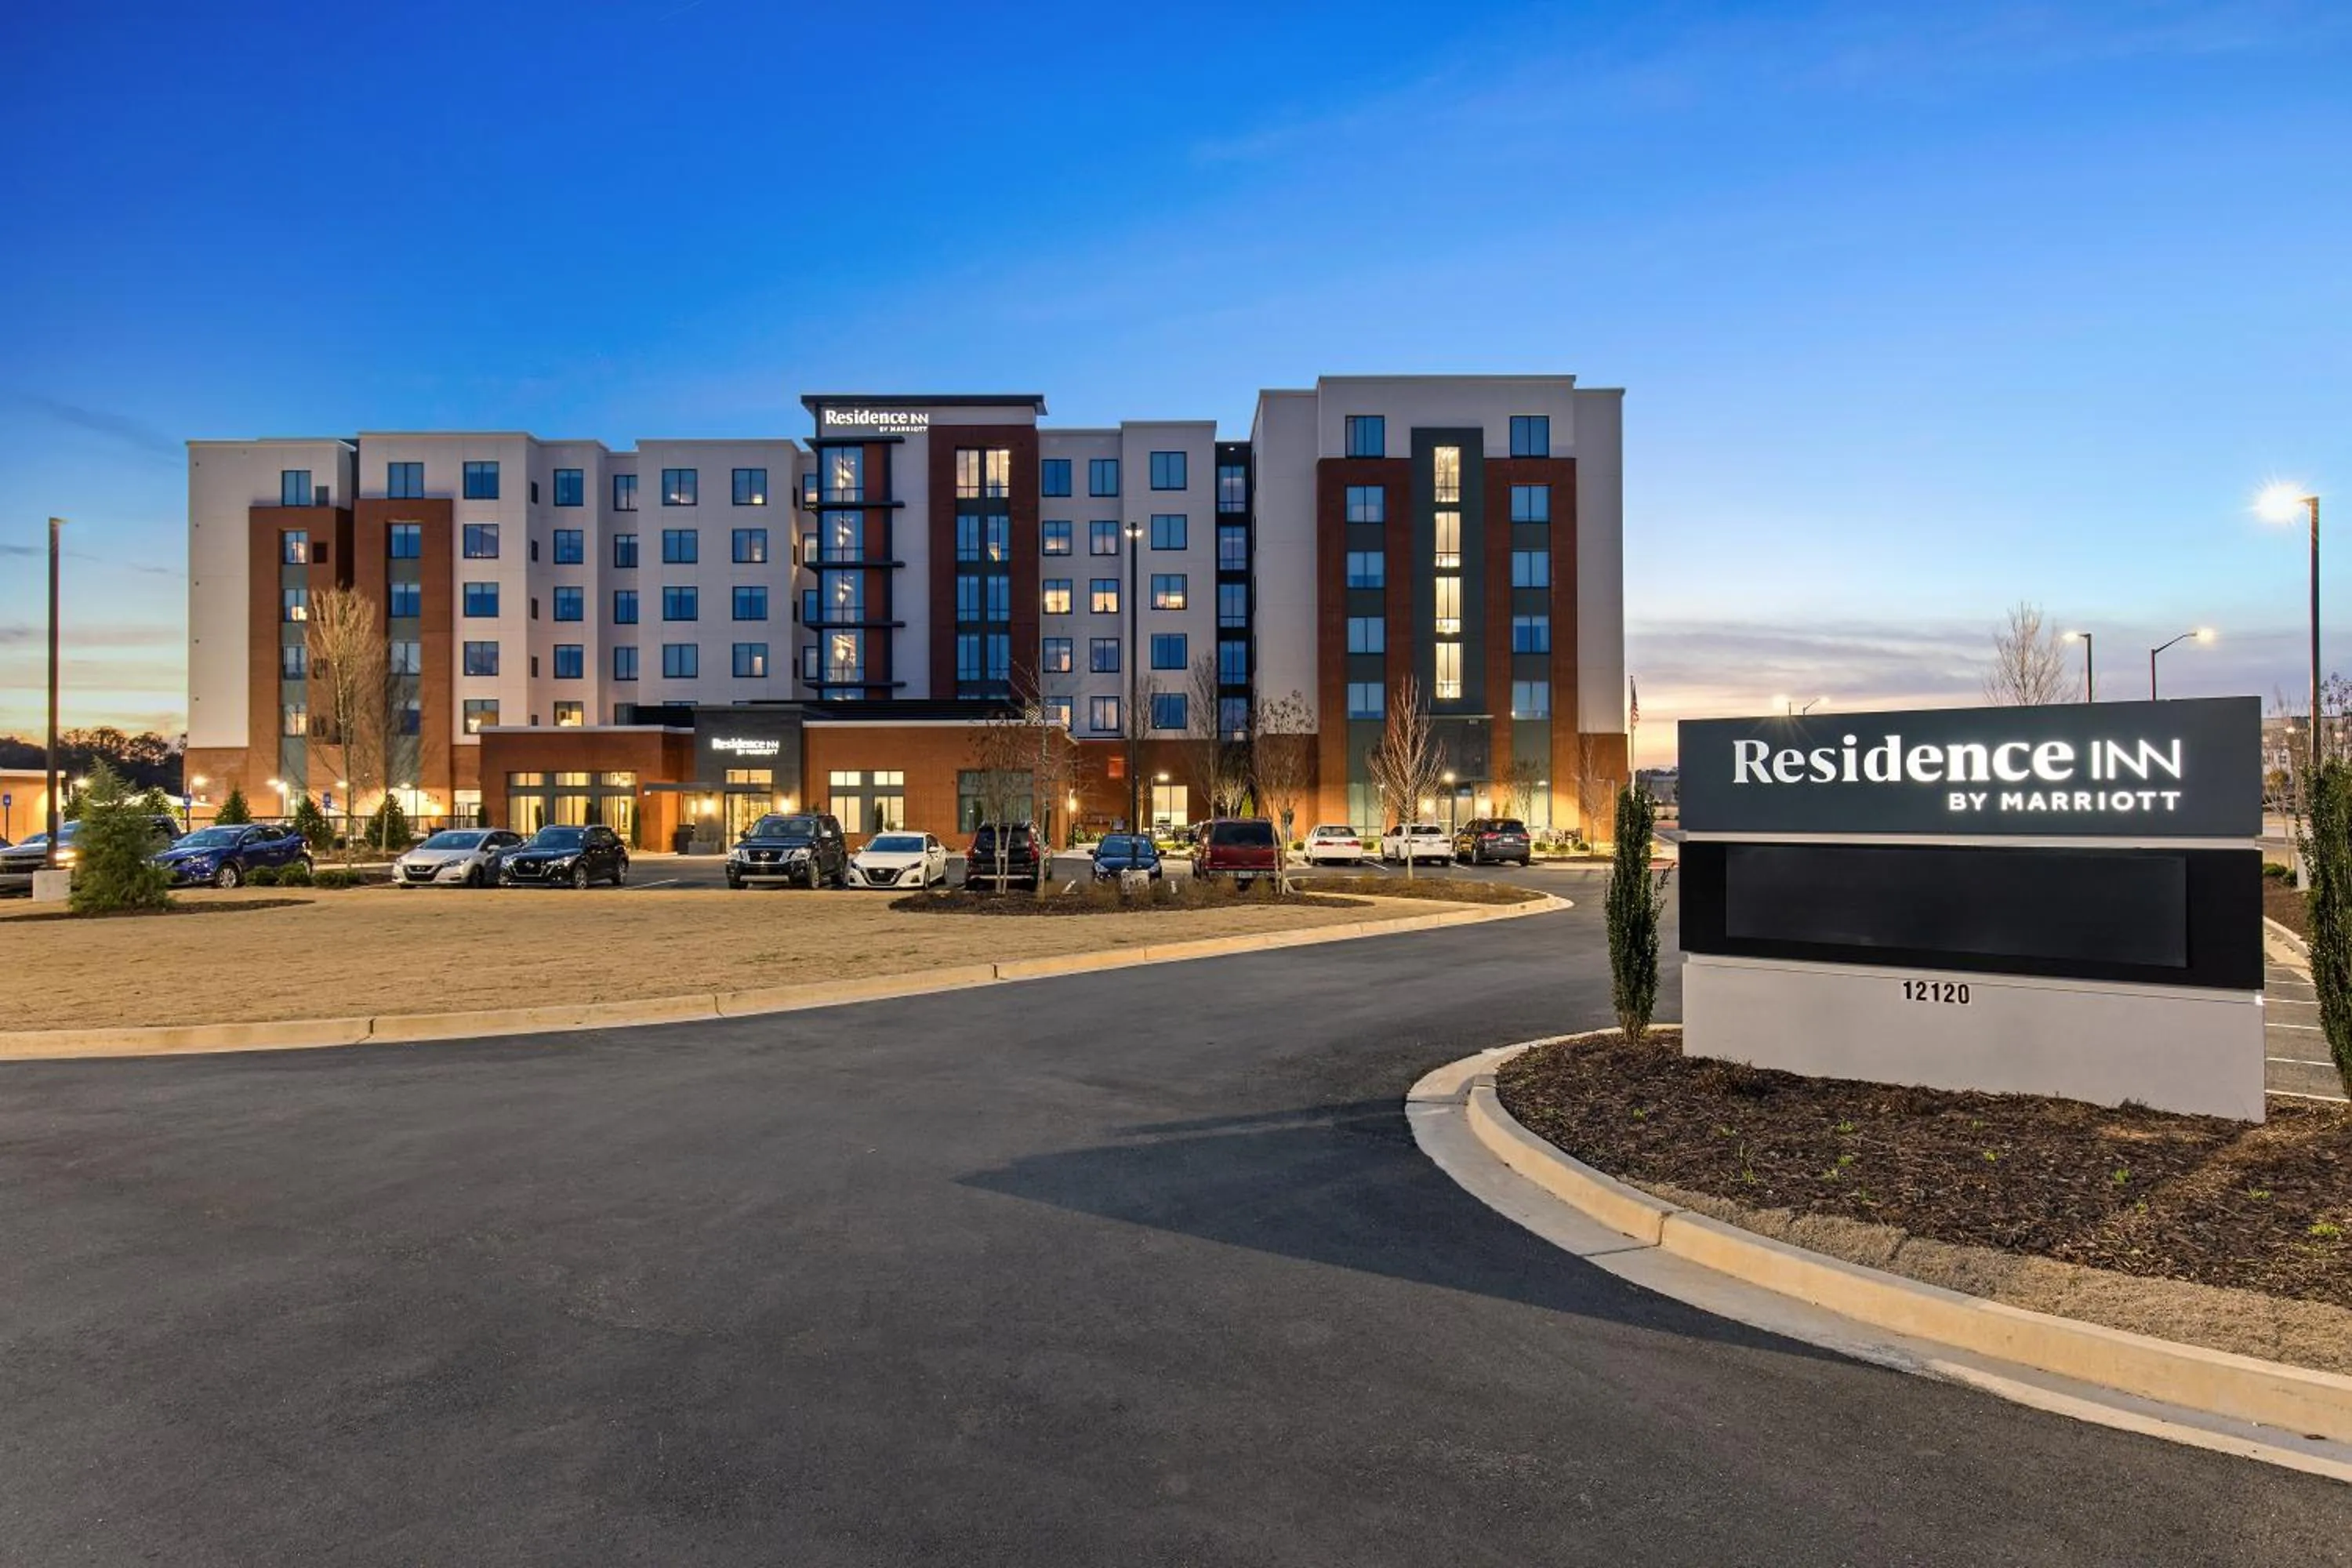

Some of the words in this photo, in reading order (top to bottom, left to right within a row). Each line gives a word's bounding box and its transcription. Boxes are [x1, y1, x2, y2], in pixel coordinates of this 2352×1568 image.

[825, 409, 908, 424] Residence
[910, 413, 929, 424] INN
[1732, 734, 2074, 783] Residence
[2091, 739, 2181, 781] INN
[1947, 791, 1987, 811] BY
[2001, 791, 2182, 812] MARRIOTT
[1903, 980, 1970, 1004] 12120
